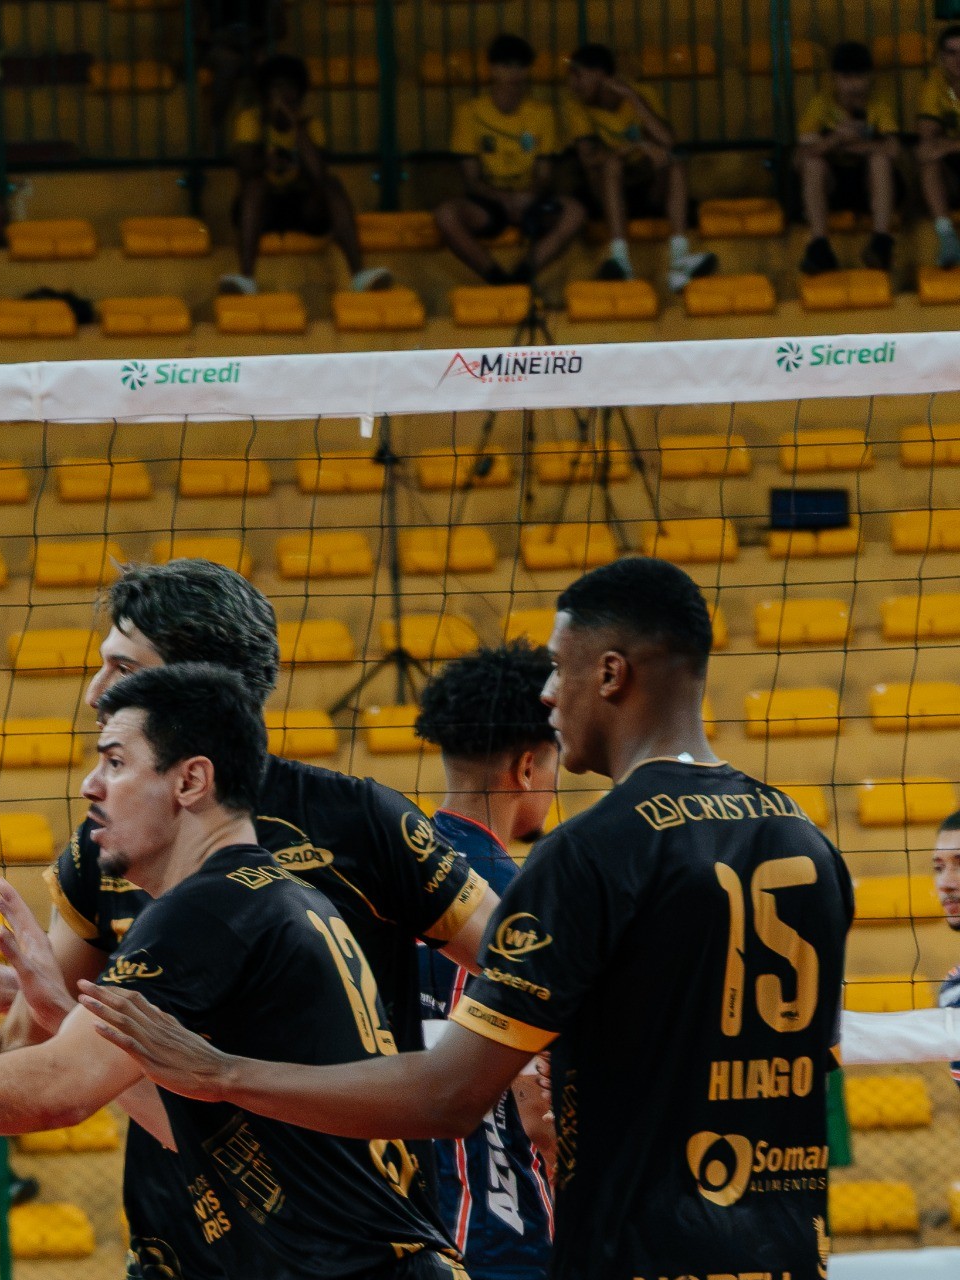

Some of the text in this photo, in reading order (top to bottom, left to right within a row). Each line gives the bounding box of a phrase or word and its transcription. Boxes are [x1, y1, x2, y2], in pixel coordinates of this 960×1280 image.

[480, 353, 583, 376] MINEIRO
[809, 341, 897, 366] Sicredi
[154, 362, 240, 385] Sicredi
[677, 788, 808, 821] CRISTÁLI
[714, 855, 820, 1037] 15
[306, 909, 400, 1057] 12
[708, 1056, 814, 1101] HIAGO
[749, 1177, 828, 1192] ALIMENTOS
